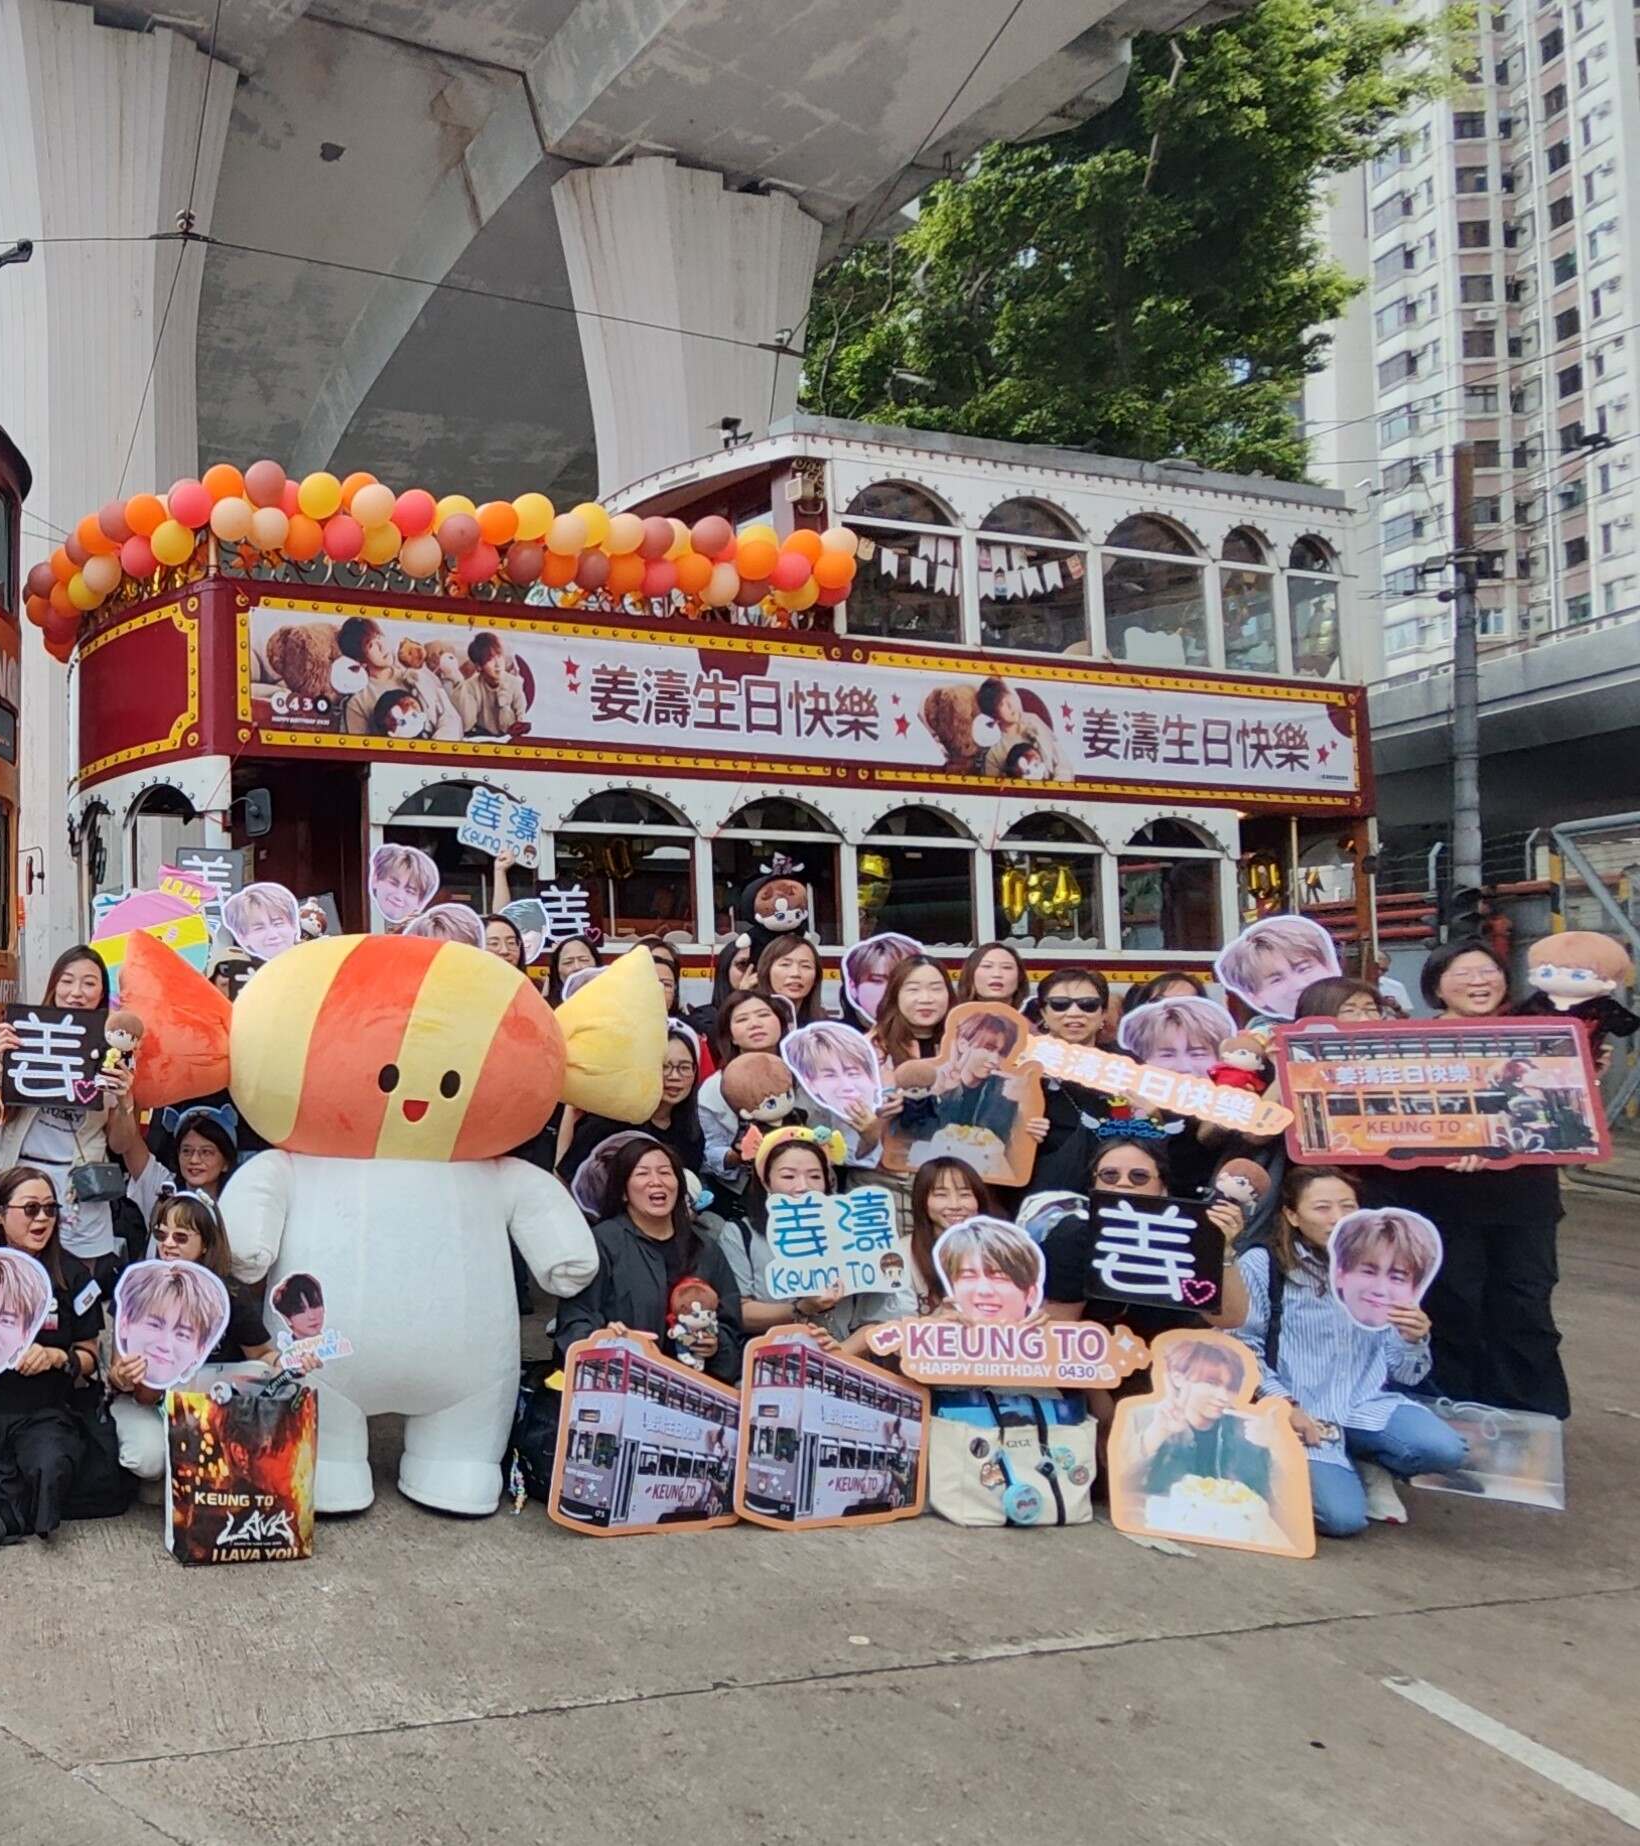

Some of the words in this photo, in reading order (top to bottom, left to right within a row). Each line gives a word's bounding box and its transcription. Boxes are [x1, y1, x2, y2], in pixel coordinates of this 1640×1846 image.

[590, 663, 880, 742] 姜濤生日快樂
[1082, 706, 1310, 772] 姜濤生日快樂
[1366, 1119, 1433, 1134] KEUNG
[1437, 1119, 1461, 1134] TO
[770, 1191, 895, 1259] 姜濤
[908, 1324, 1045, 1361] KEUNG
[1051, 1327, 1107, 1362] TO
[919, 1361, 971, 1376] HAPPY
[973, 1362, 1052, 1378] BIRTHDAY
[1058, 1365, 1096, 1379] 0430
[651, 1483, 685, 1501] KEUNG
[834, 1476, 868, 1493] KEUNG
[194, 1491, 250, 1507] KEUNG
[255, 1495, 275, 1507] TO
[215, 1509, 295, 1549] LAVA
[220, 1548, 261, 1562] LAVA
[263, 1547, 299, 1561] YOU
